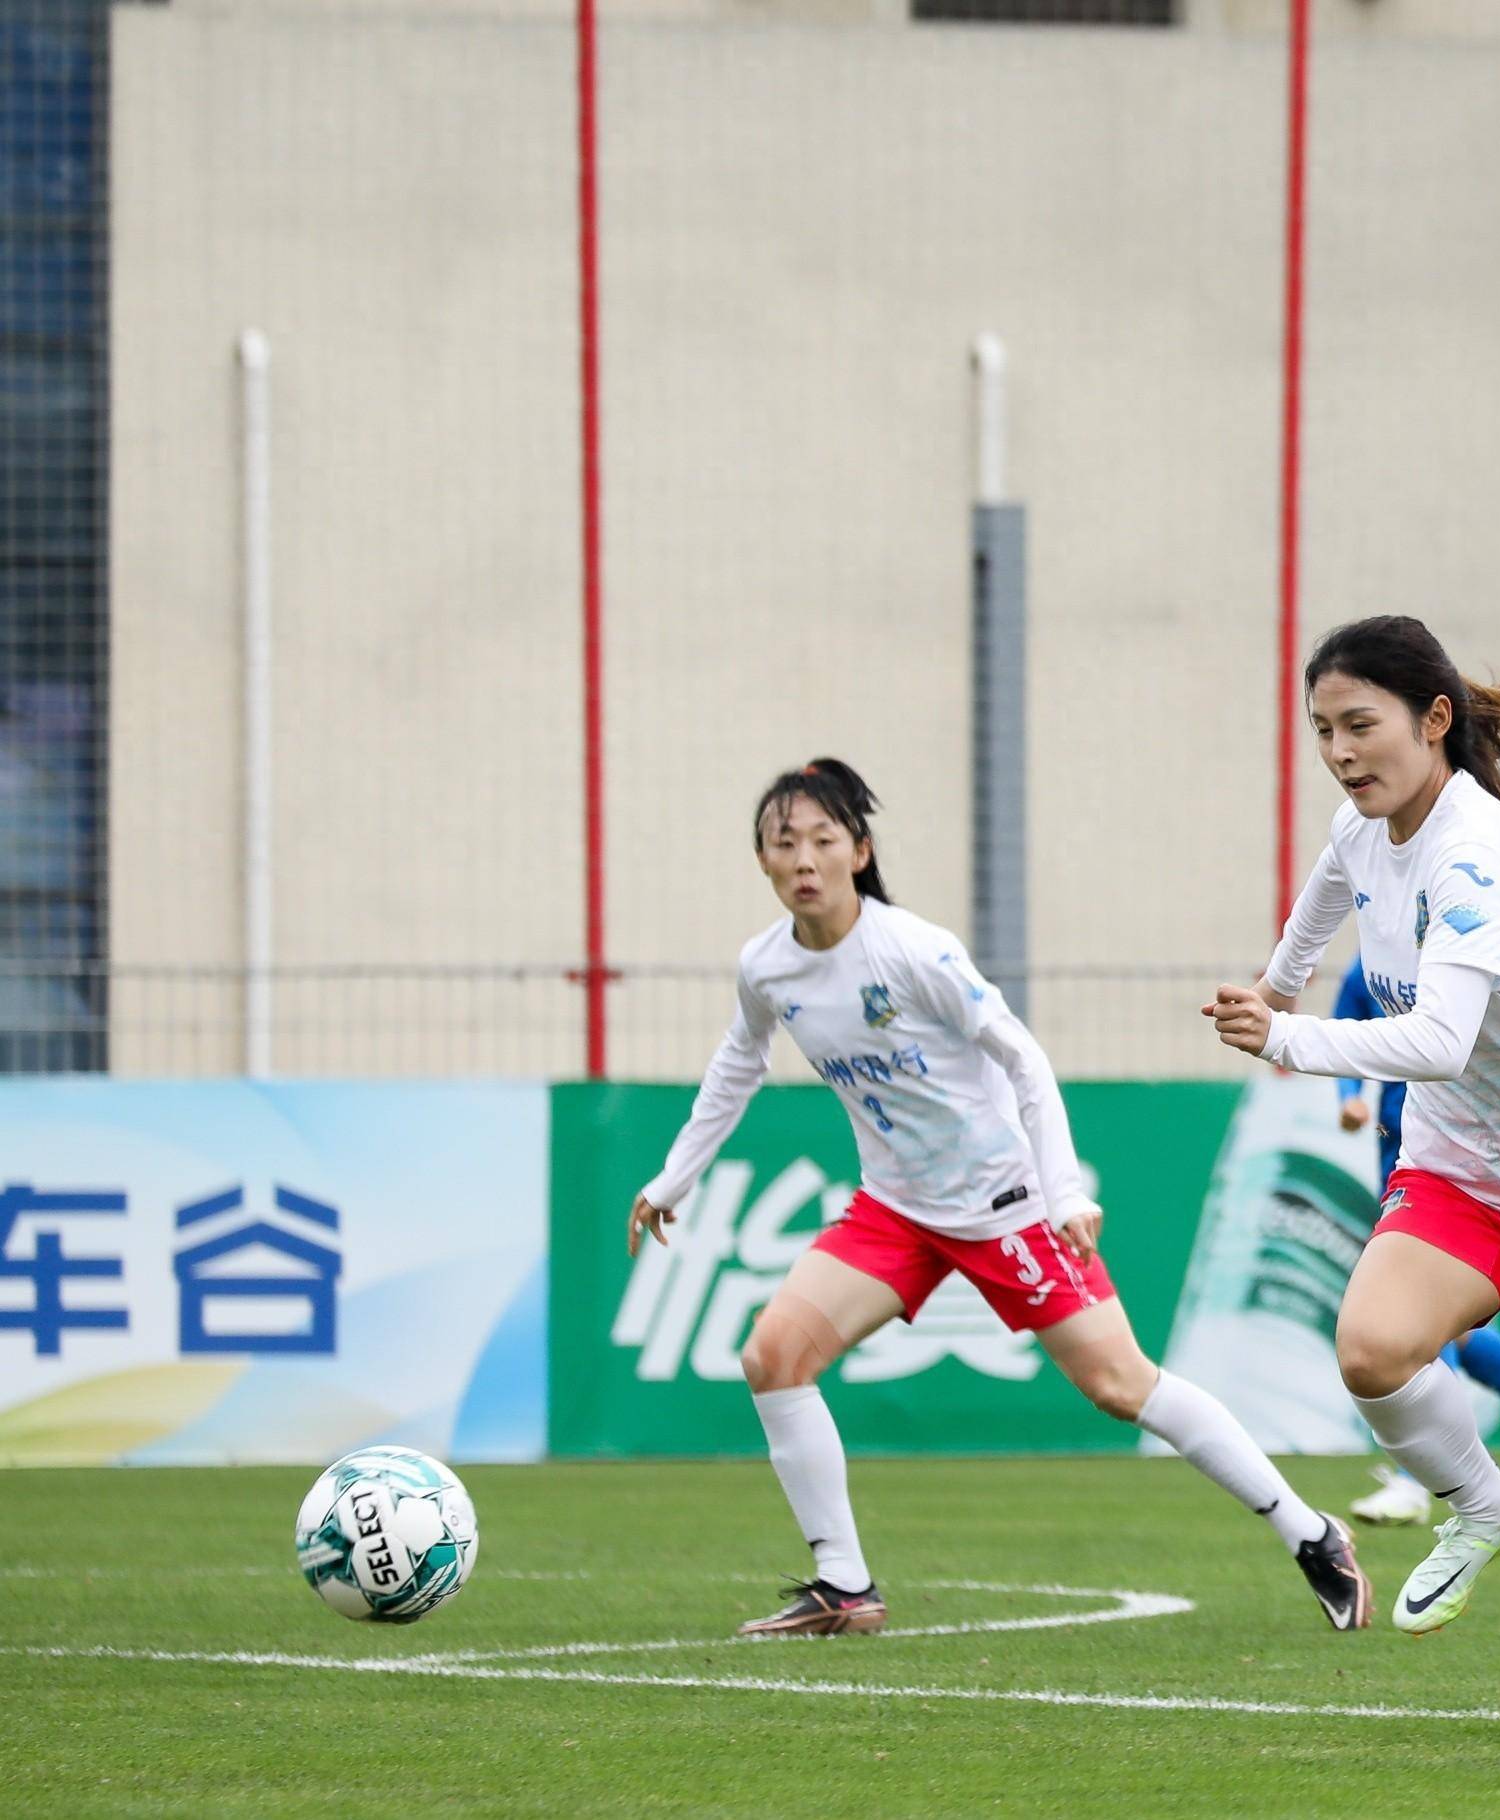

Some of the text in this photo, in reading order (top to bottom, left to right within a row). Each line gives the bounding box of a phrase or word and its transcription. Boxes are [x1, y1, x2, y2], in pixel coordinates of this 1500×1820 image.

[862, 1094, 894, 1132] 3
[0, 1184, 342, 1355] 车谷
[1001, 1234, 1043, 1286] 3
[351, 1491, 400, 1586] SELECT
